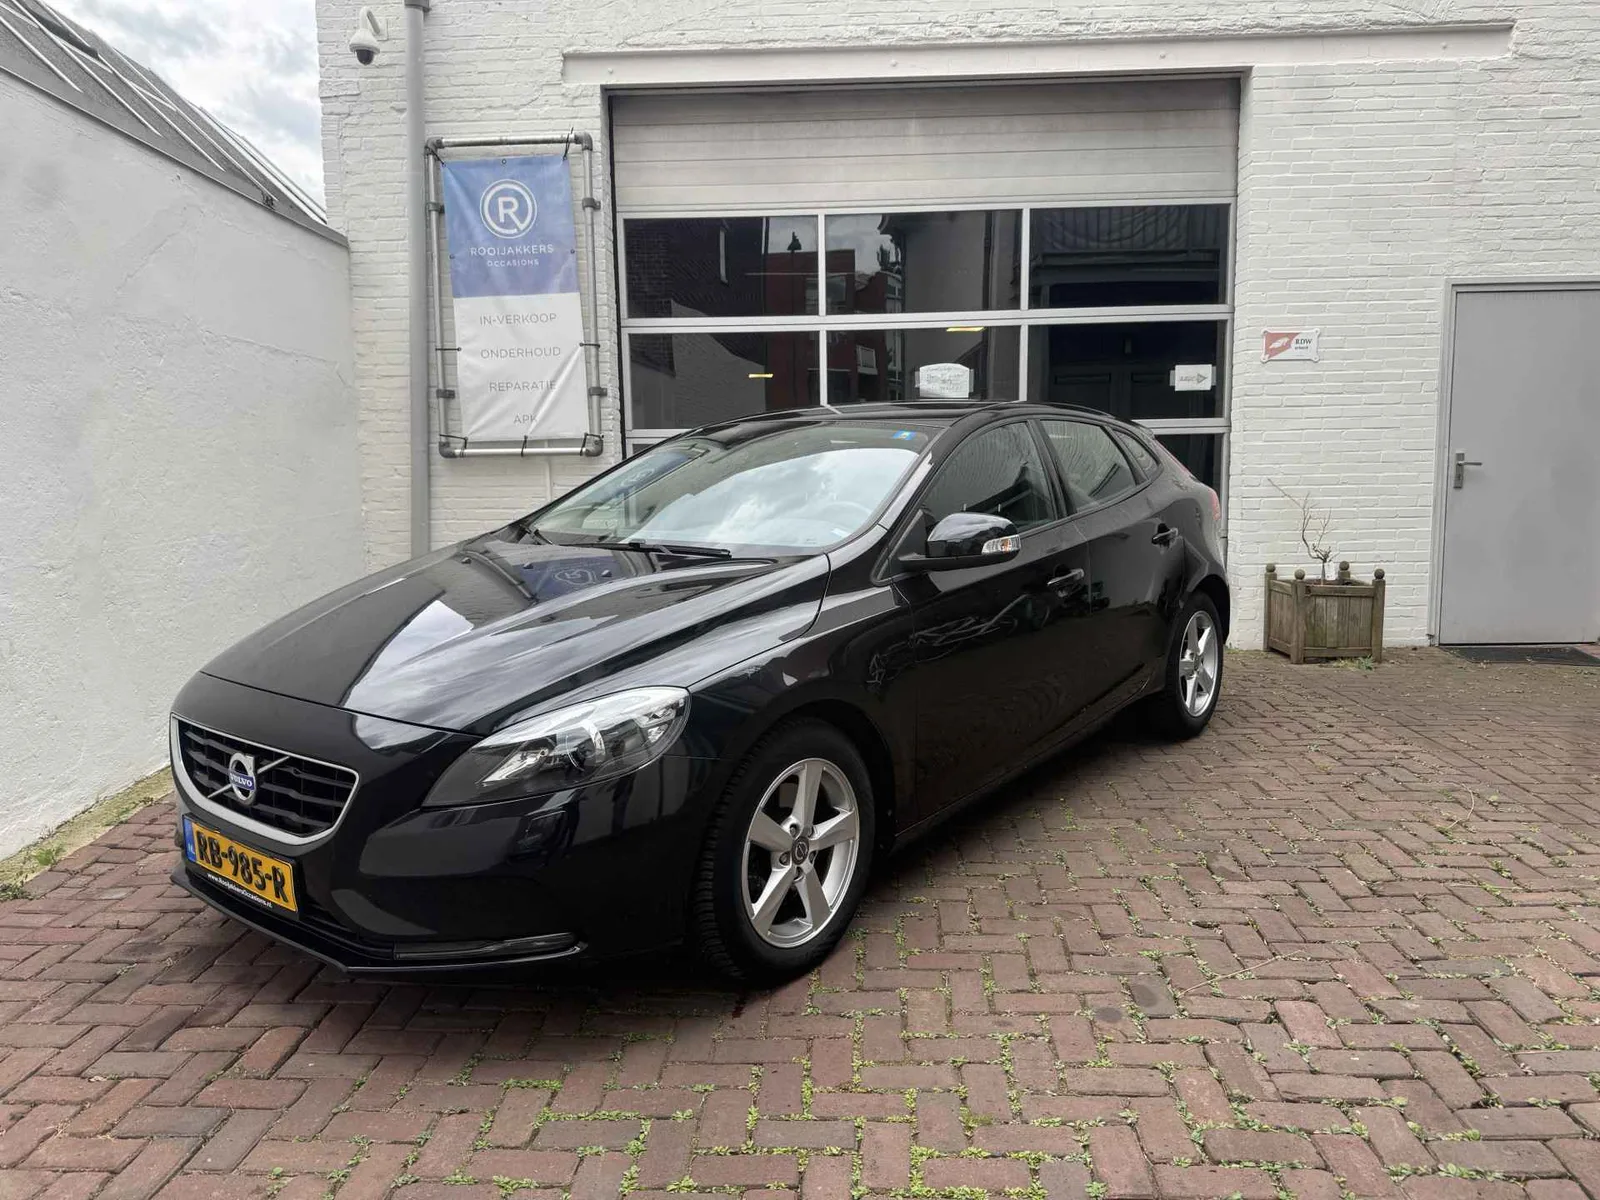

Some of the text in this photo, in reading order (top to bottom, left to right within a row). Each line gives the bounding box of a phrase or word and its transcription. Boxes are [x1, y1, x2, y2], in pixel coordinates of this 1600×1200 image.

[470, 243, 554, 256] ROOIJAKKERS
[487, 259, 540, 268] OCCASIONS
[479, 312, 557, 326] IN-VERKOOP
[480, 346, 561, 359] ONDERHOUD
[489, 380, 557, 392] REPARATIE
[513, 413, 538, 424] APK
[229, 772, 252, 788] VOLVO
[195, 830, 289, 903] RB-985-R
